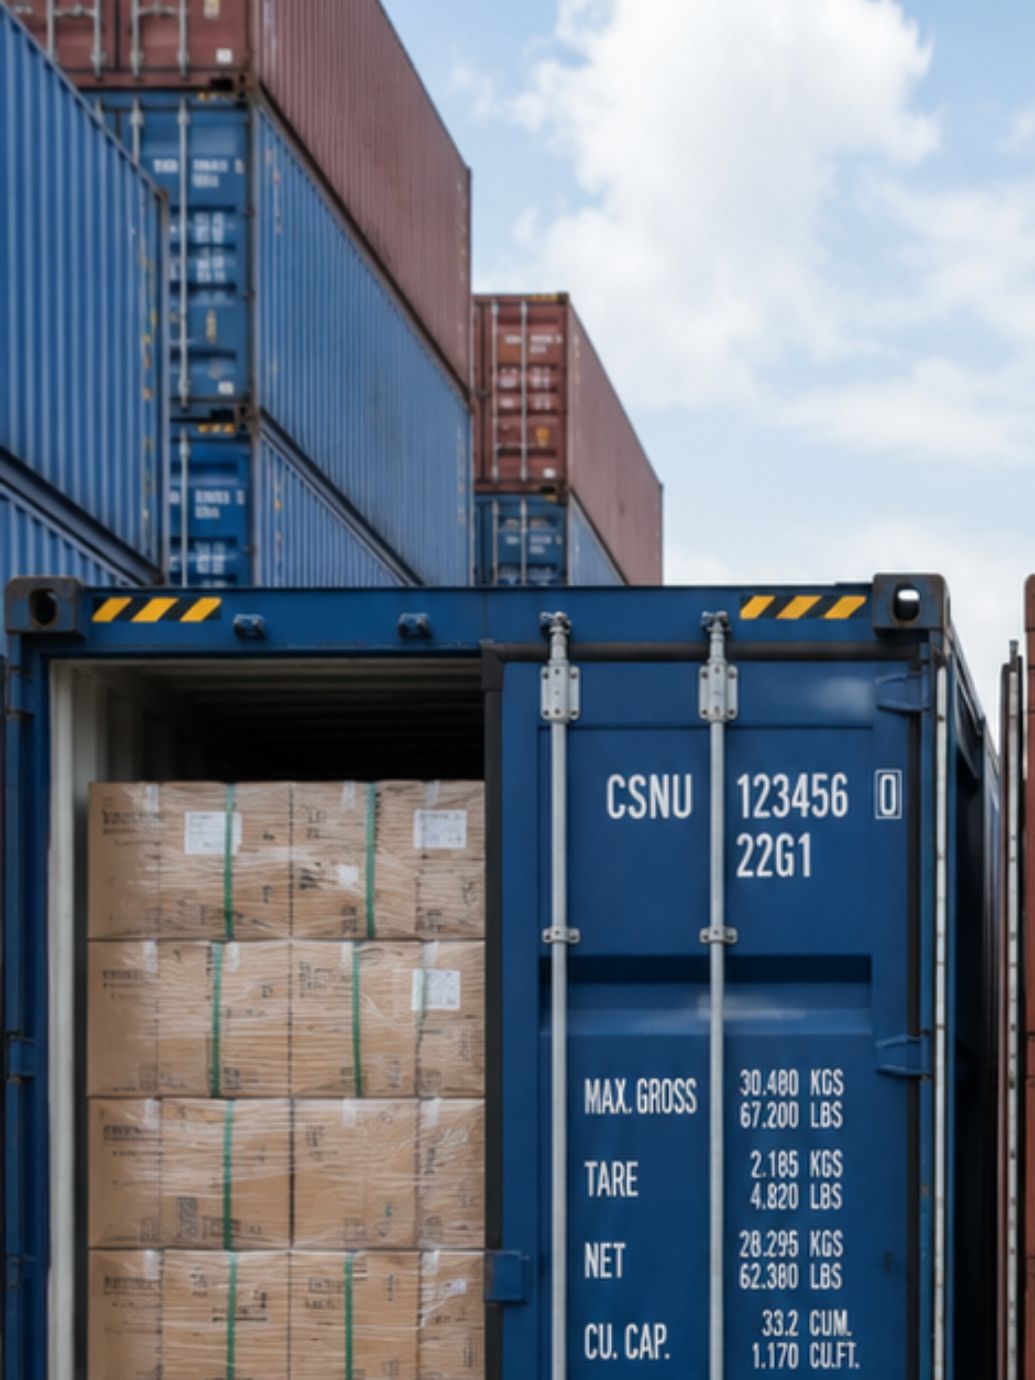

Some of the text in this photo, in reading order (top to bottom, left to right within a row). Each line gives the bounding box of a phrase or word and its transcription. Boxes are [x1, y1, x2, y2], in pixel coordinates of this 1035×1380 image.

[607, 774, 692, 819] CSNU
[737, 772, 848, 818] 123456
[737, 832, 810, 877] 22G1
[585, 1078, 697, 1114] MAX. GROSS
[740, 1069, 844, 1096] 30.480 KGS
[740, 1101, 843, 1128] 67.200 LBS
[751, 1149, 843, 1178] 2.185 KGS
[585, 1161, 638, 1197] TARE
[751, 1182, 842, 1210] 4.820 LBS
[740, 1230, 843, 1257] 28.295 KGS
[585, 1242, 626, 1278] NET
[740, 1262, 842, 1289] 62.380 LBS
[762, 1309, 798, 1336] 33.2
[585, 1323, 669, 1360] CU. CAP.
[753, 1341, 859, 1369] 1.170 CU.FT.
